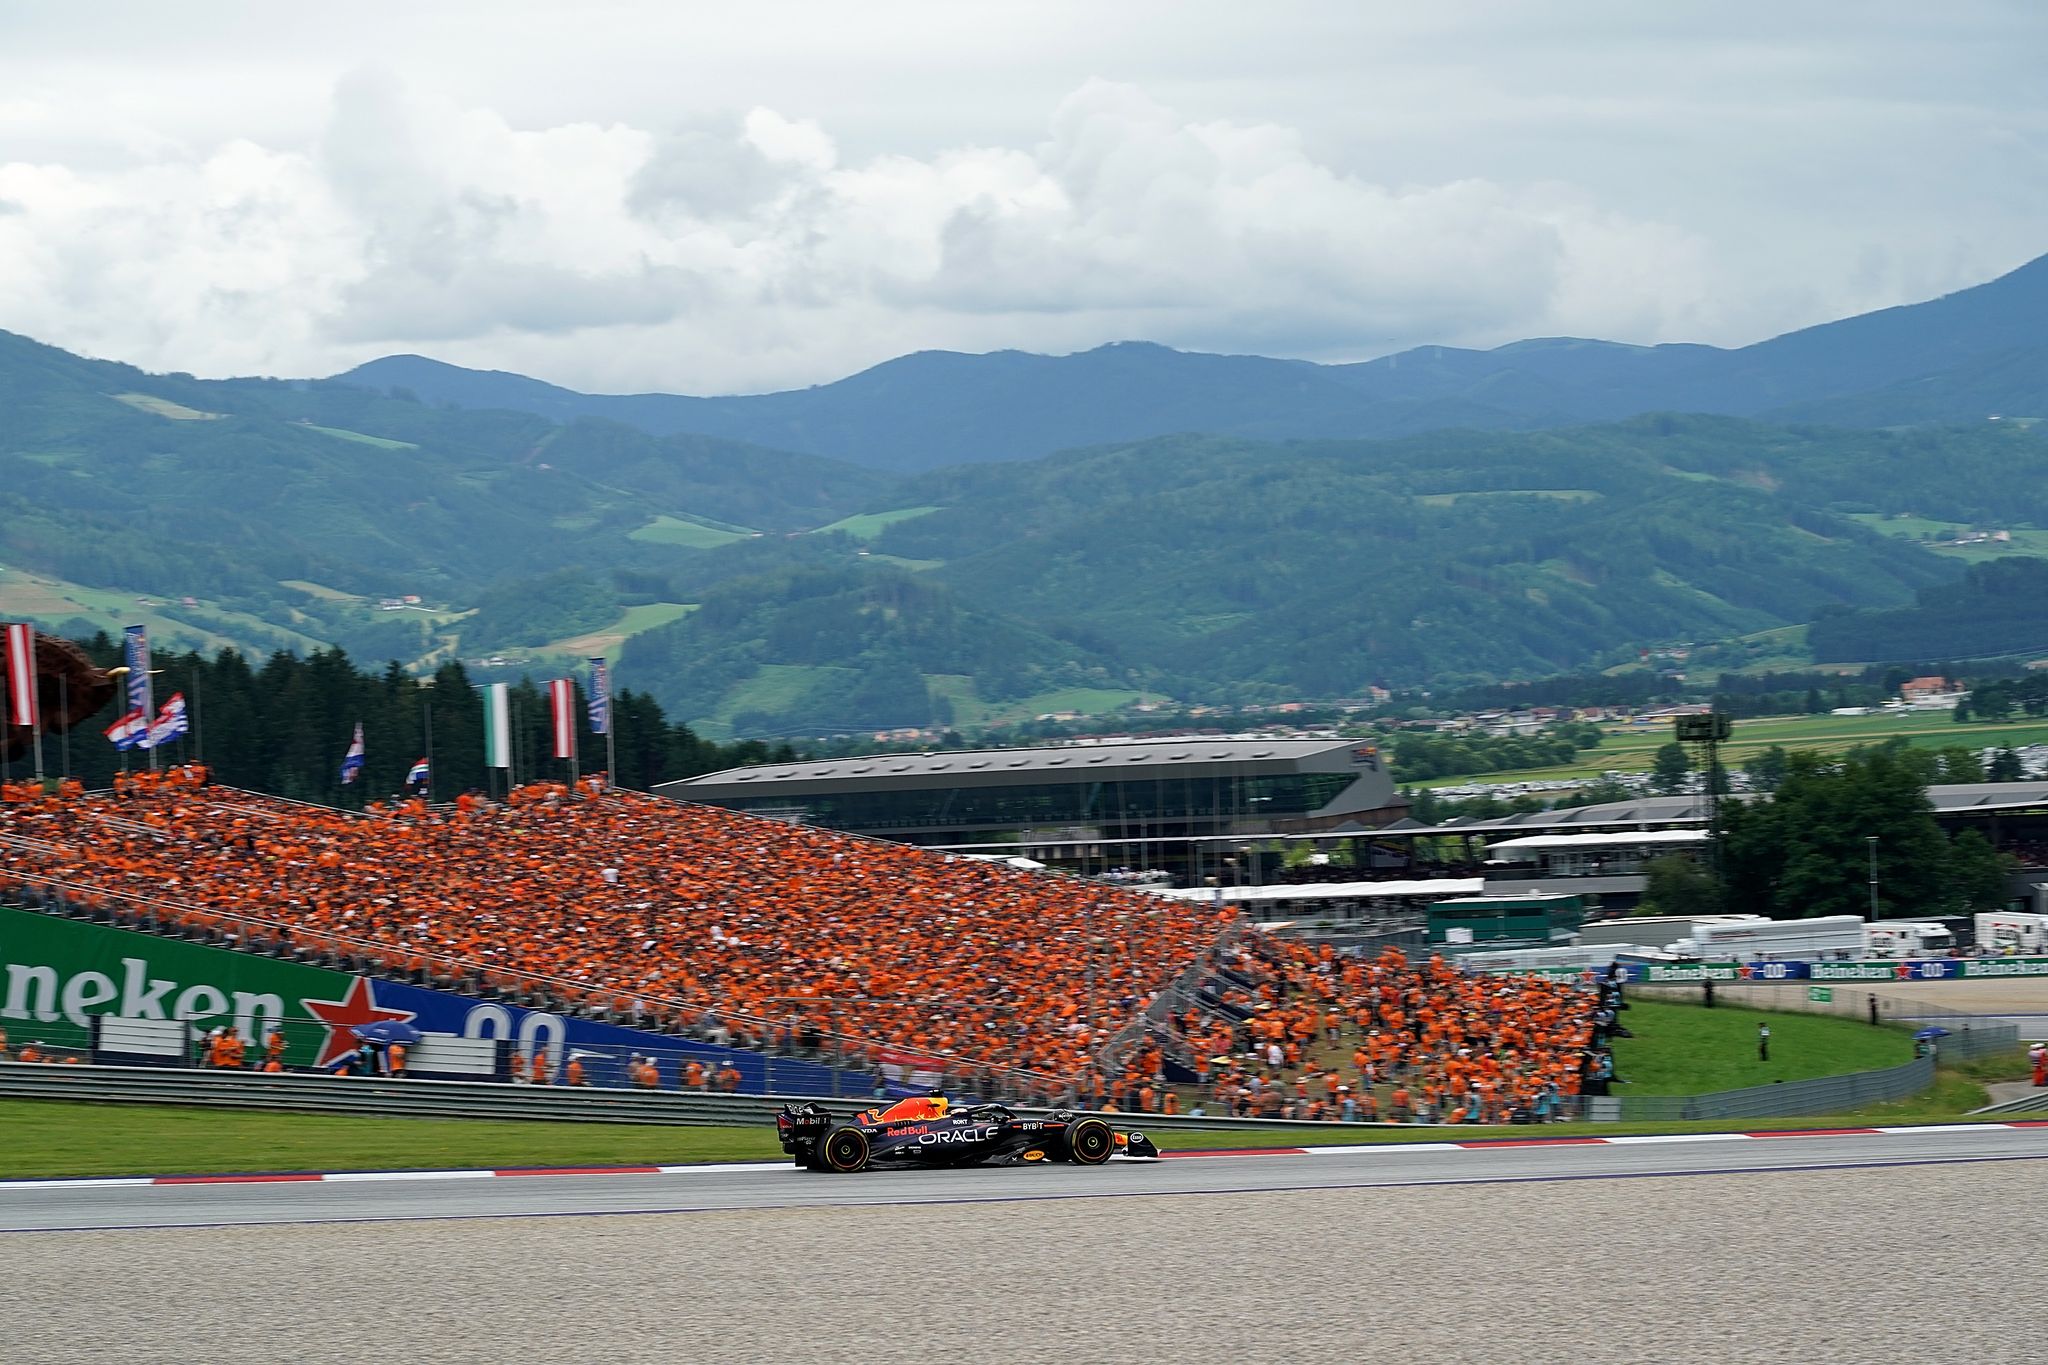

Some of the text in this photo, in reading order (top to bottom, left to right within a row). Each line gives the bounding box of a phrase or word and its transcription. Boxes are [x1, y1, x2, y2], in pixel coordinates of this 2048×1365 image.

[1648, 965, 1735, 981] Heineken
[1810, 964, 1892, 979] Heineken
[796, 1117, 820, 1125] Mobil
[918, 1126, 999, 1145] ORACLE
